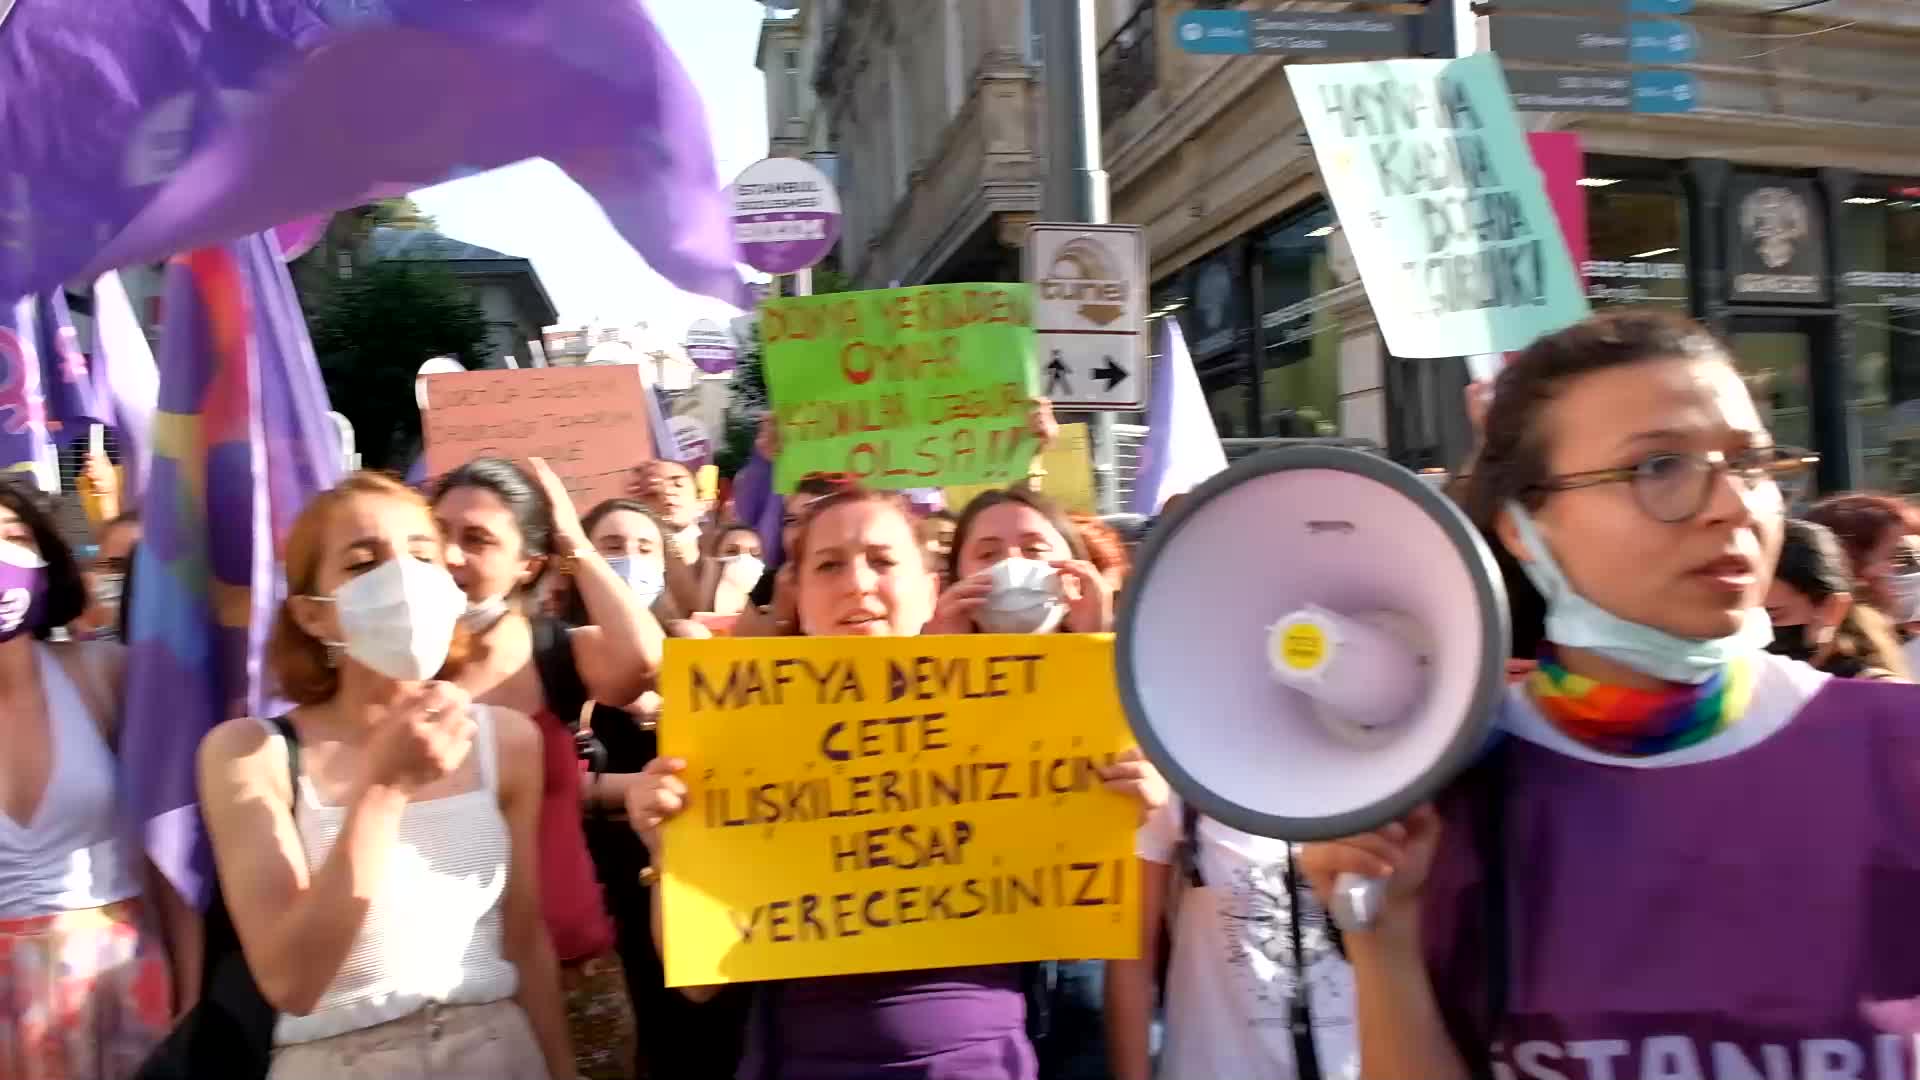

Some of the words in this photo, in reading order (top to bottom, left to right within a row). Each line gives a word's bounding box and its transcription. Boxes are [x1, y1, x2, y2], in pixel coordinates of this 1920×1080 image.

[687, 657, 866, 712] MAFYA
[887, 653, 1047, 703] DEVLET
[830, 819, 976, 873] HESAP
[730, 842, 1126, 945] VERECEKSİNİZ!
